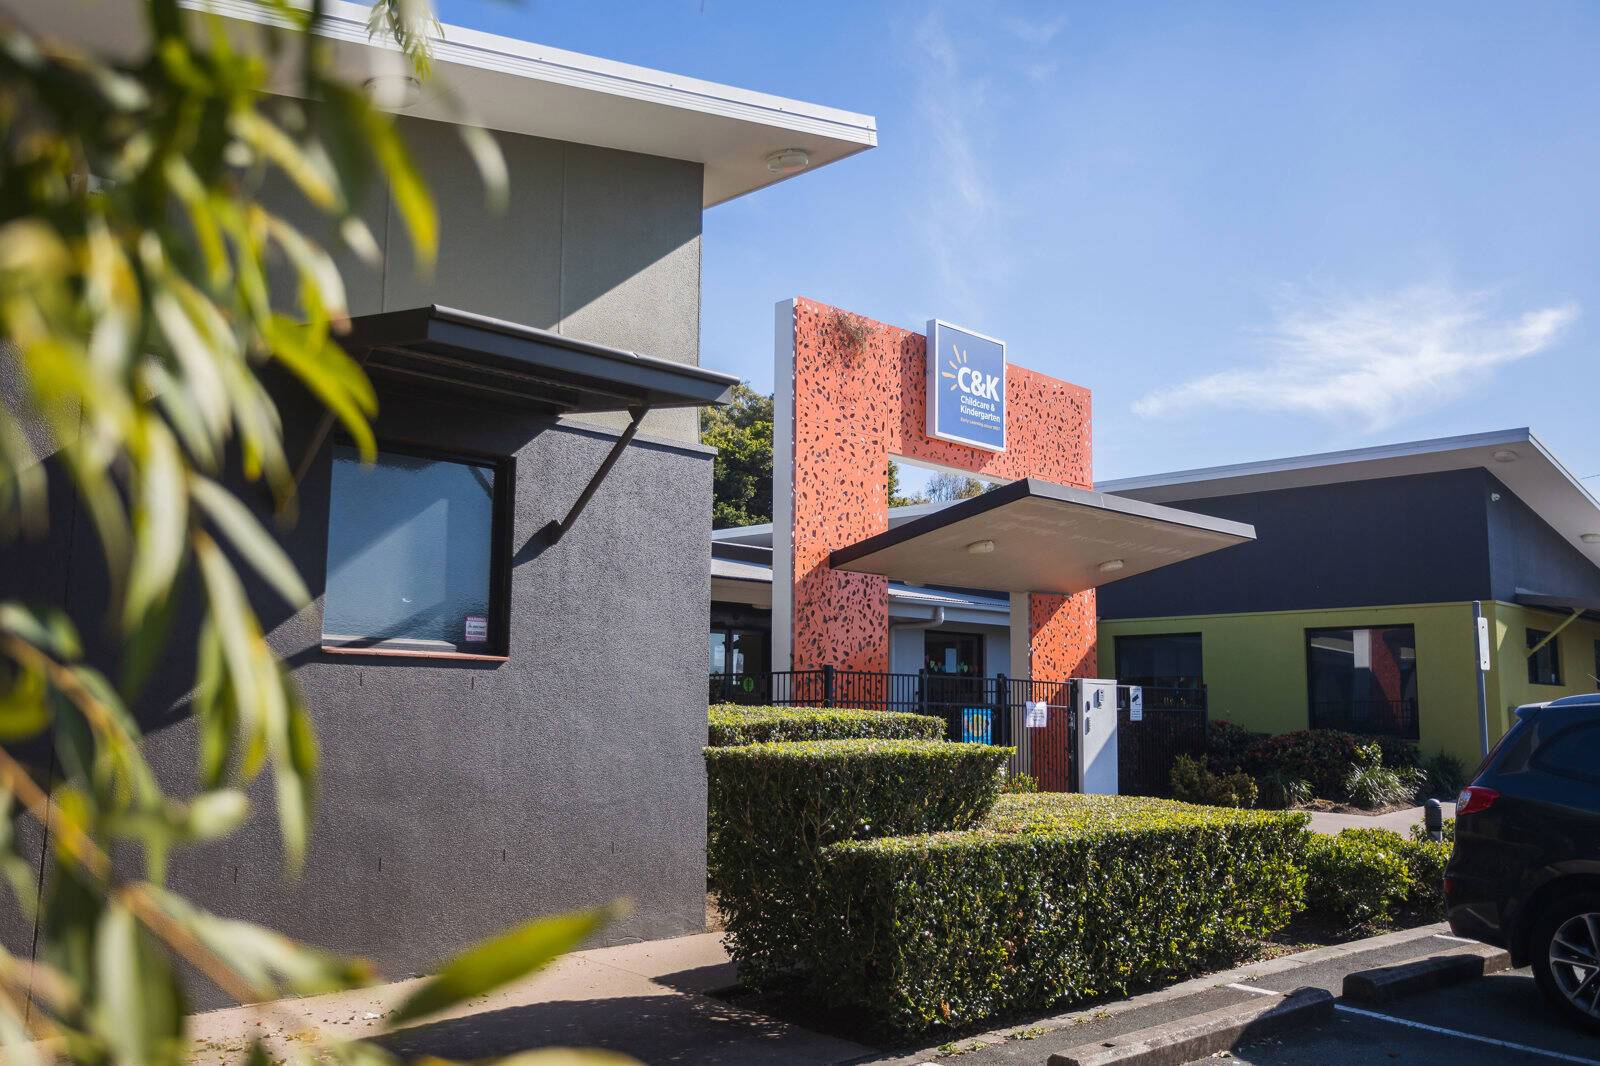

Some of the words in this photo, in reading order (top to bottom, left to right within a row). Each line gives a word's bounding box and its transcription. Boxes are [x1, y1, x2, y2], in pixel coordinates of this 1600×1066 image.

[958, 367, 1000, 402] C&K
[960, 395, 990, 410] Childcare
[990, 403, 995, 412] &
[960, 404, 1001, 423] Kindergarten
